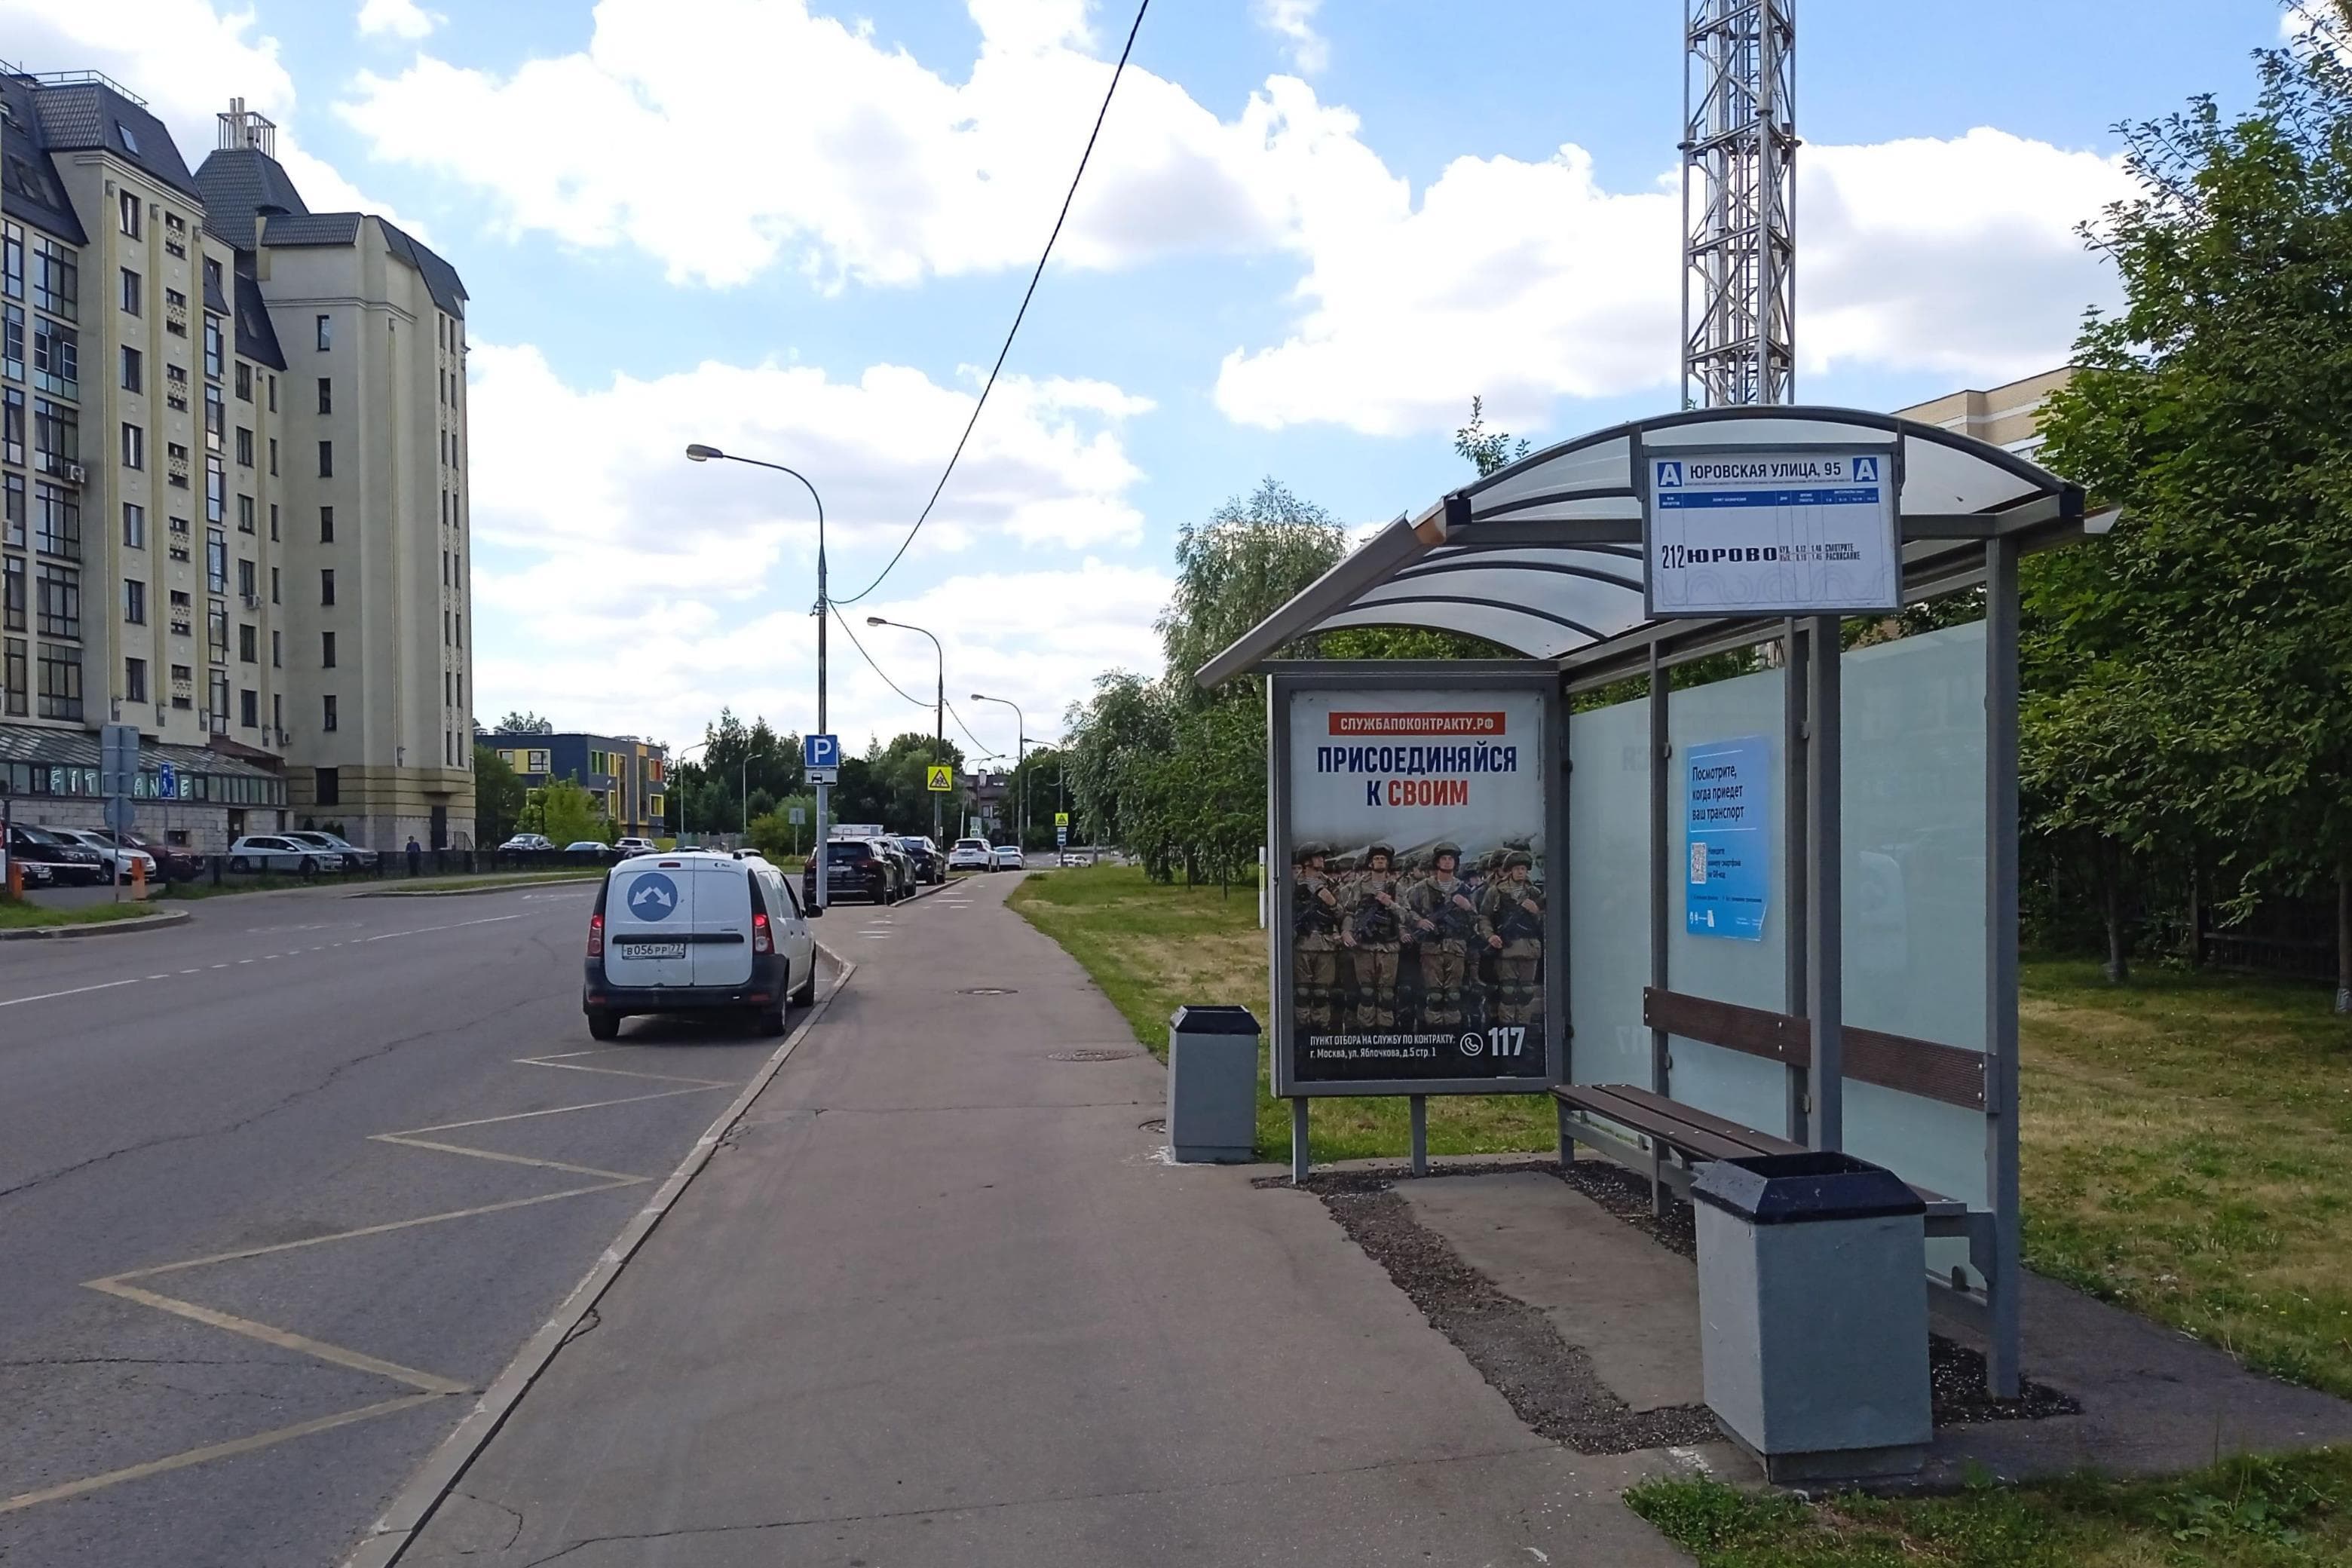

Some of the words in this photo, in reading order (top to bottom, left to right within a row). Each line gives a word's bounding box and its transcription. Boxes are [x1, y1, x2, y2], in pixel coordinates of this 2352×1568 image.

[1690, 464, 1767, 479] ЮРОВСКАЯ
[1771, 463, 1820, 479] УЛИЦА,
[1824, 462, 1841, 476] 95
[1661, 544, 1685, 569] 212
[1687, 547, 1778, 563] ЮРОВО
[1340, 718, 1494, 730] СЛУЖБАПОКОНТРАКТУ.РФ
[813, 739, 831, 763] P
[1317, 740, 1517, 775] ПРИСОЕДИНЯЙСЯ
[1692, 765, 1737, 782] Посмотрите,
[1367, 780, 1382, 806] К
[1388, 780, 1468, 806] СВОИМ
[1692, 788, 1711, 803] когда
[1712, 785, 1743, 802] приедет
[1692, 809, 1706, 820] ваш
[1707, 806, 1744, 823] транспорт
[1310, 1036, 1333, 1046] ПУНКТ
[1334, 1035, 1361, 1045] ОТБОРА
[1362, 1035, 1372, 1045] НА
[1373, 1034, 1401, 1045] СЛУЖБУ
[1403, 1034, 1413, 1044] ПО
[1414, 1034, 1456, 1044] КОНТРАКТУ:
[1488, 1027, 1525, 1055] 117
[1310, 1050, 1315, 1058] г.
[1317, 1049, 1347, 1058] Москва,
[1348, 1049, 1359, 1059] ул.
[1360, 1048, 1401, 1059] Яблочкова,
